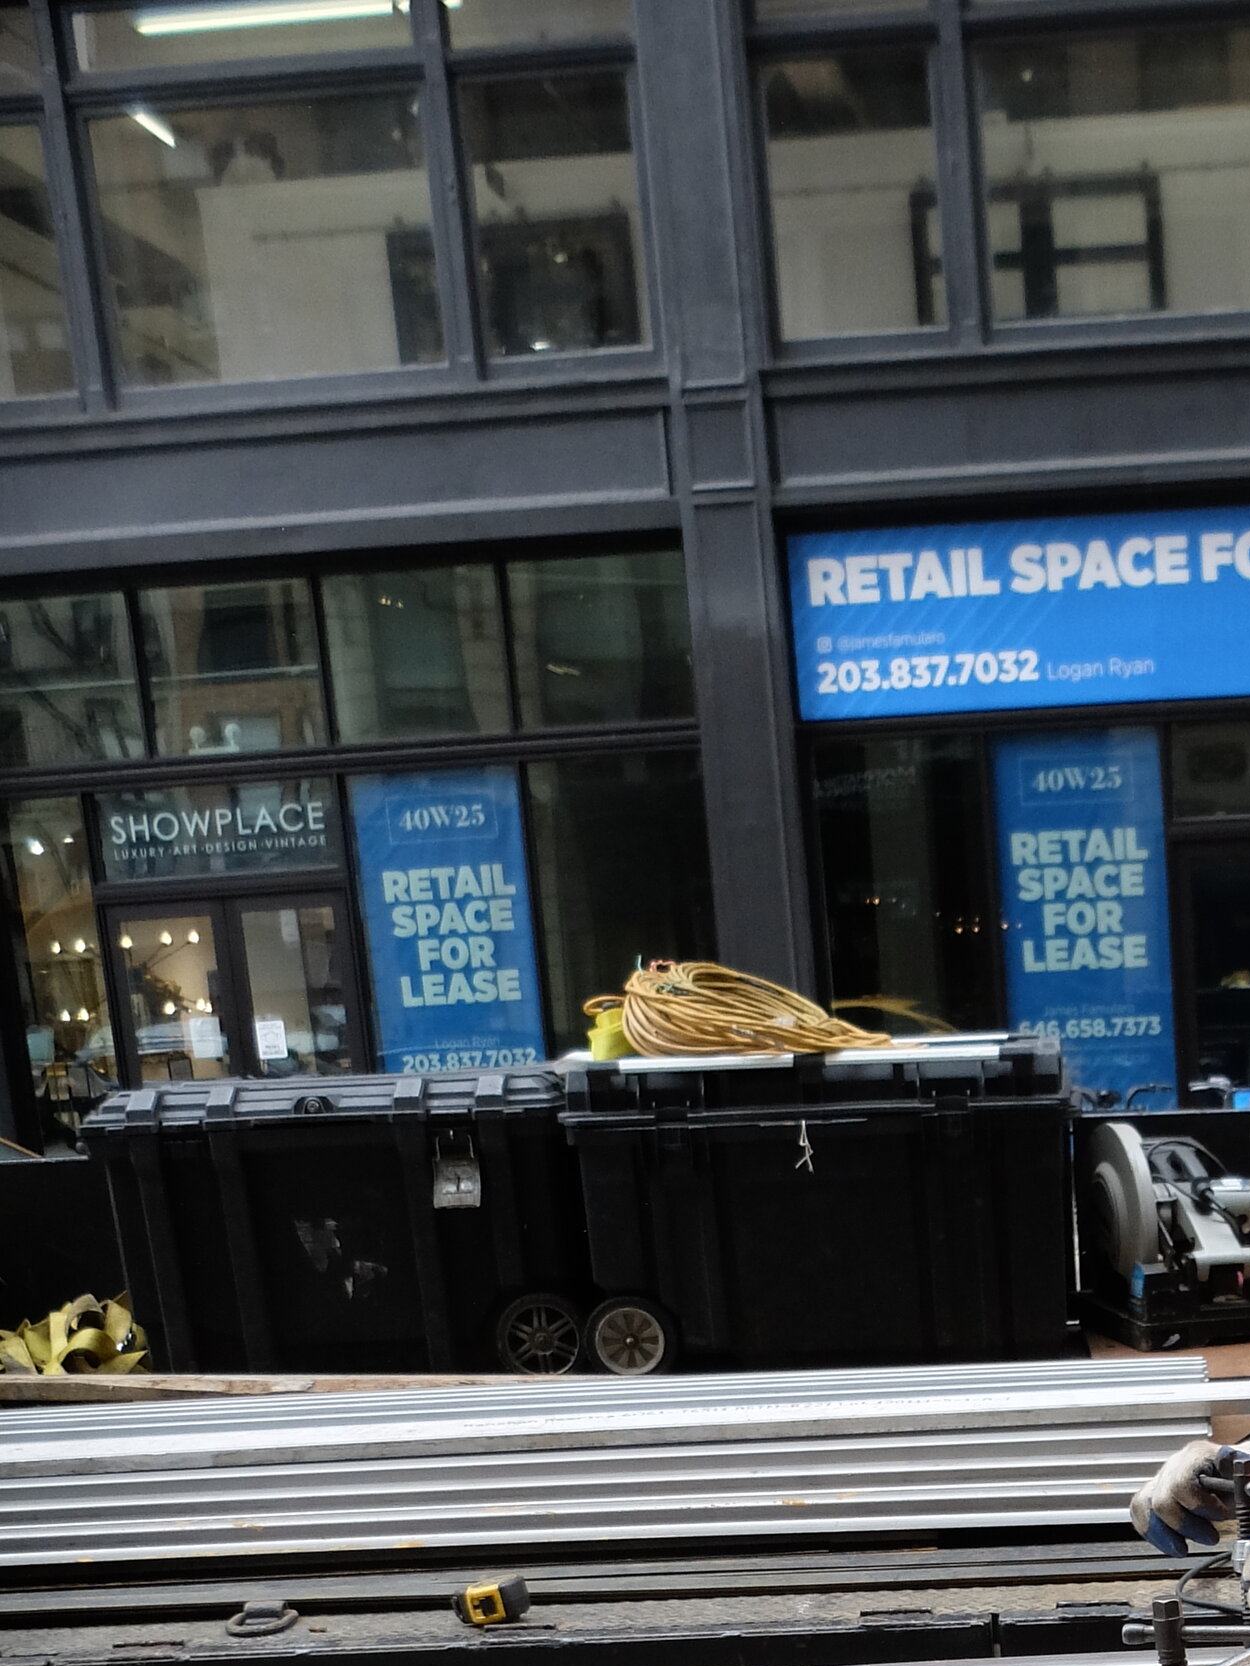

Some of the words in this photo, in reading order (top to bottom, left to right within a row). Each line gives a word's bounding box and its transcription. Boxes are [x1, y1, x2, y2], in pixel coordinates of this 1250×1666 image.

[808, 549, 999, 606] RETAIL
[1010, 535, 1188, 593] SPACE
[817, 649, 1038, 693] 203.837.7032
[1047, 660, 1103, 682] Logan
[1110, 656, 1154, 679] Ryan
[1032, 765, 1121, 792] 40W25
[110, 801, 325, 844] SHOWPLACE
[400, 803, 485, 830] 40W25
[113, 847, 164, 860] LUXURY
[172, 845, 197, 856] ART
[205, 840, 257, 854] DESIGN
[264, 834, 326, 848] VINTAGE
[1010, 827, 1147, 865] RETAIL
[382, 864, 515, 903] RETAIL
[1018, 863, 1145, 901] SPACE
[392, 899, 514, 937] SPACE
[1043, 901, 1122, 935] FOR
[418, 936, 495, 970] FOR
[1022, 935, 1147, 972] LEASE
[400, 969, 521, 1007] LEASE
[402, 1047, 537, 1074] 203.837.7032
